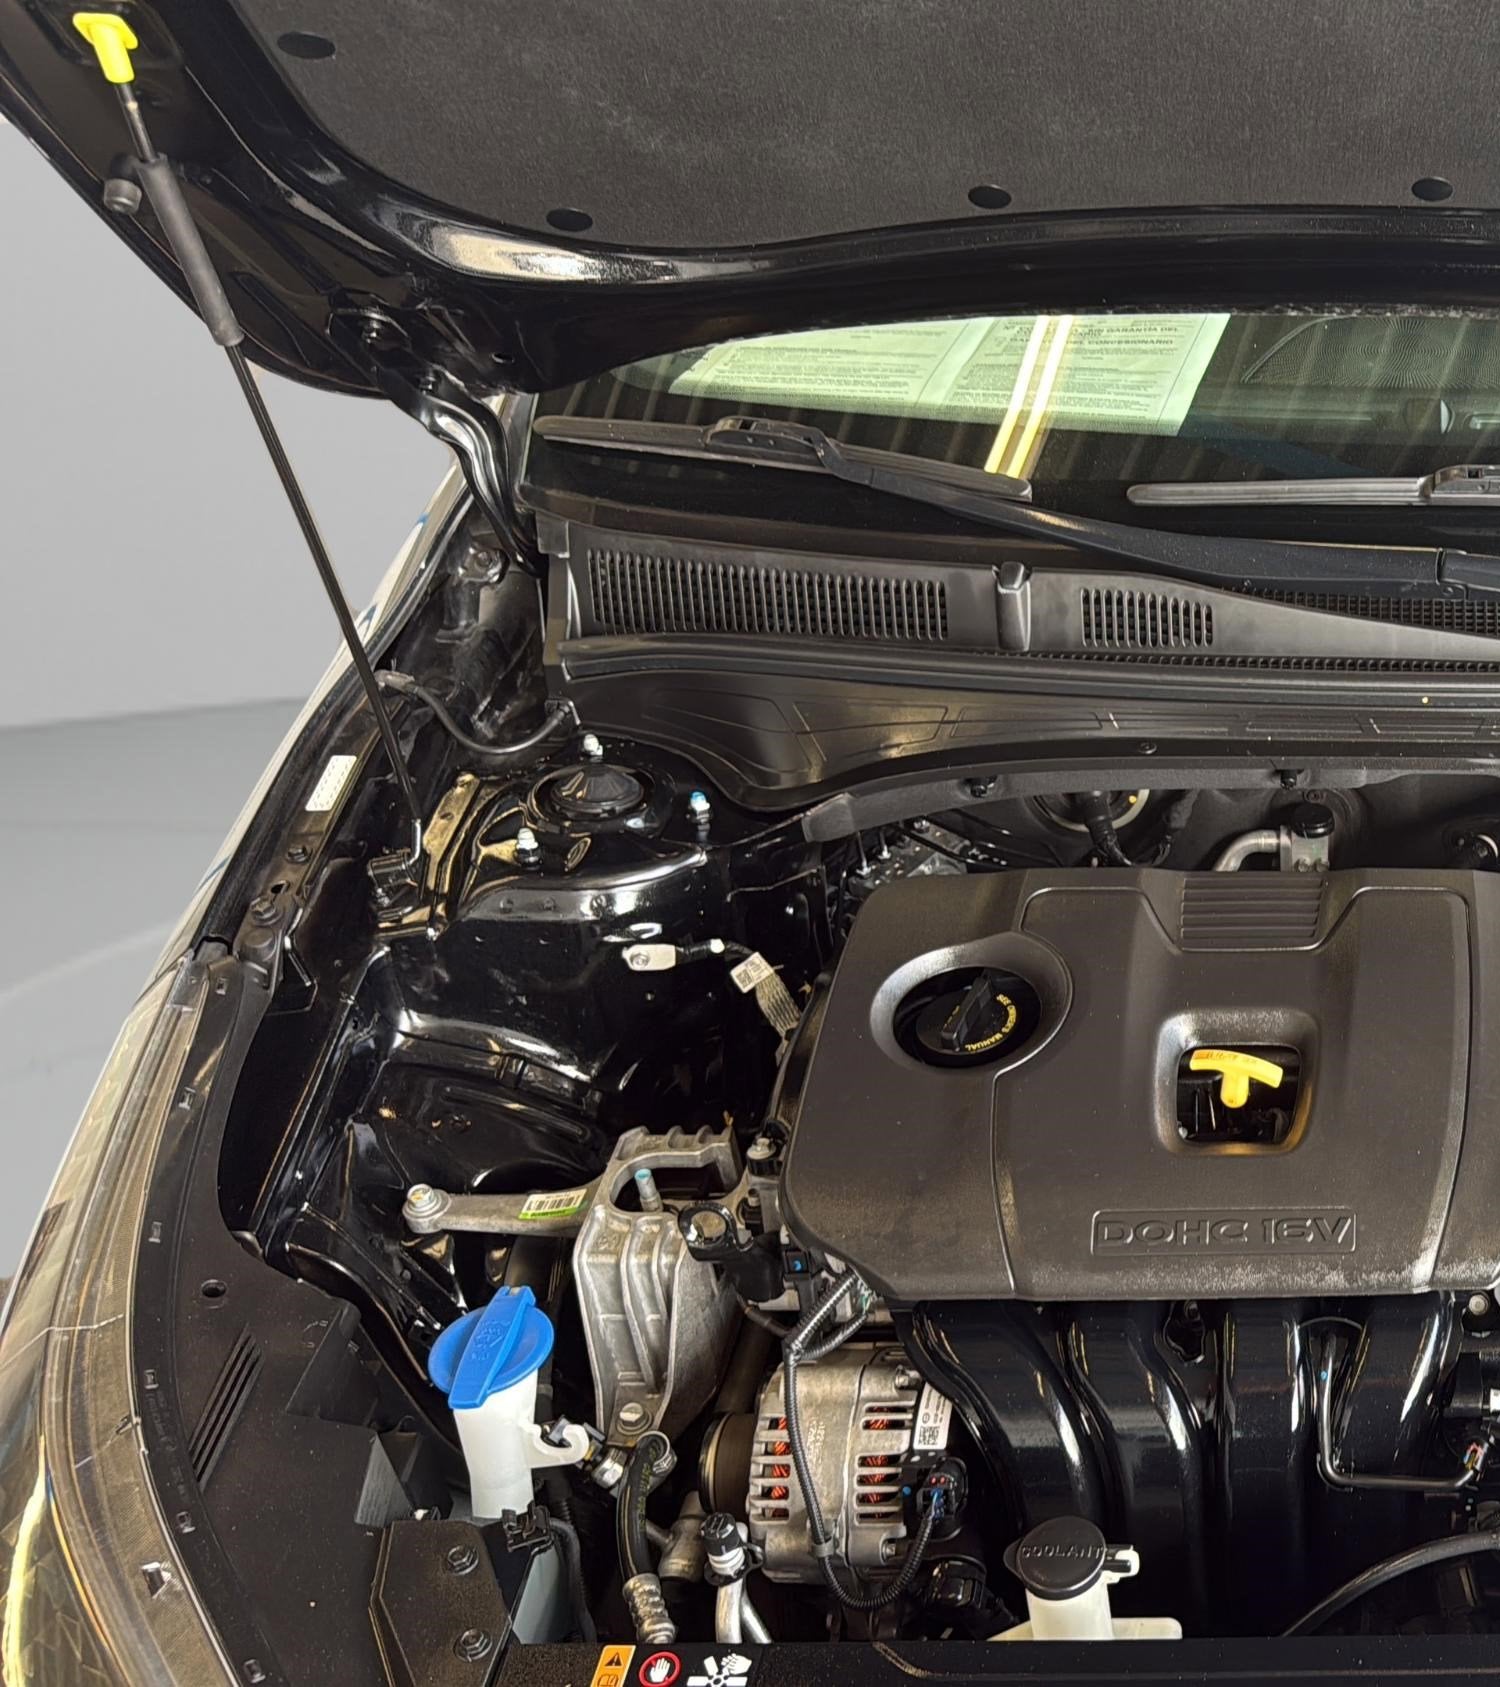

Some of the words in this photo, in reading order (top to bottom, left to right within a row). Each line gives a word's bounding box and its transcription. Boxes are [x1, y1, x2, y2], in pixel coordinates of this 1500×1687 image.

[964, 1032, 1003, 1051] MANUAL
[1096, 1218, 1249, 1247] DOHC
[1261, 1215, 1352, 1245] 16V
[1022, 1544, 1105, 1559] COOLANT
